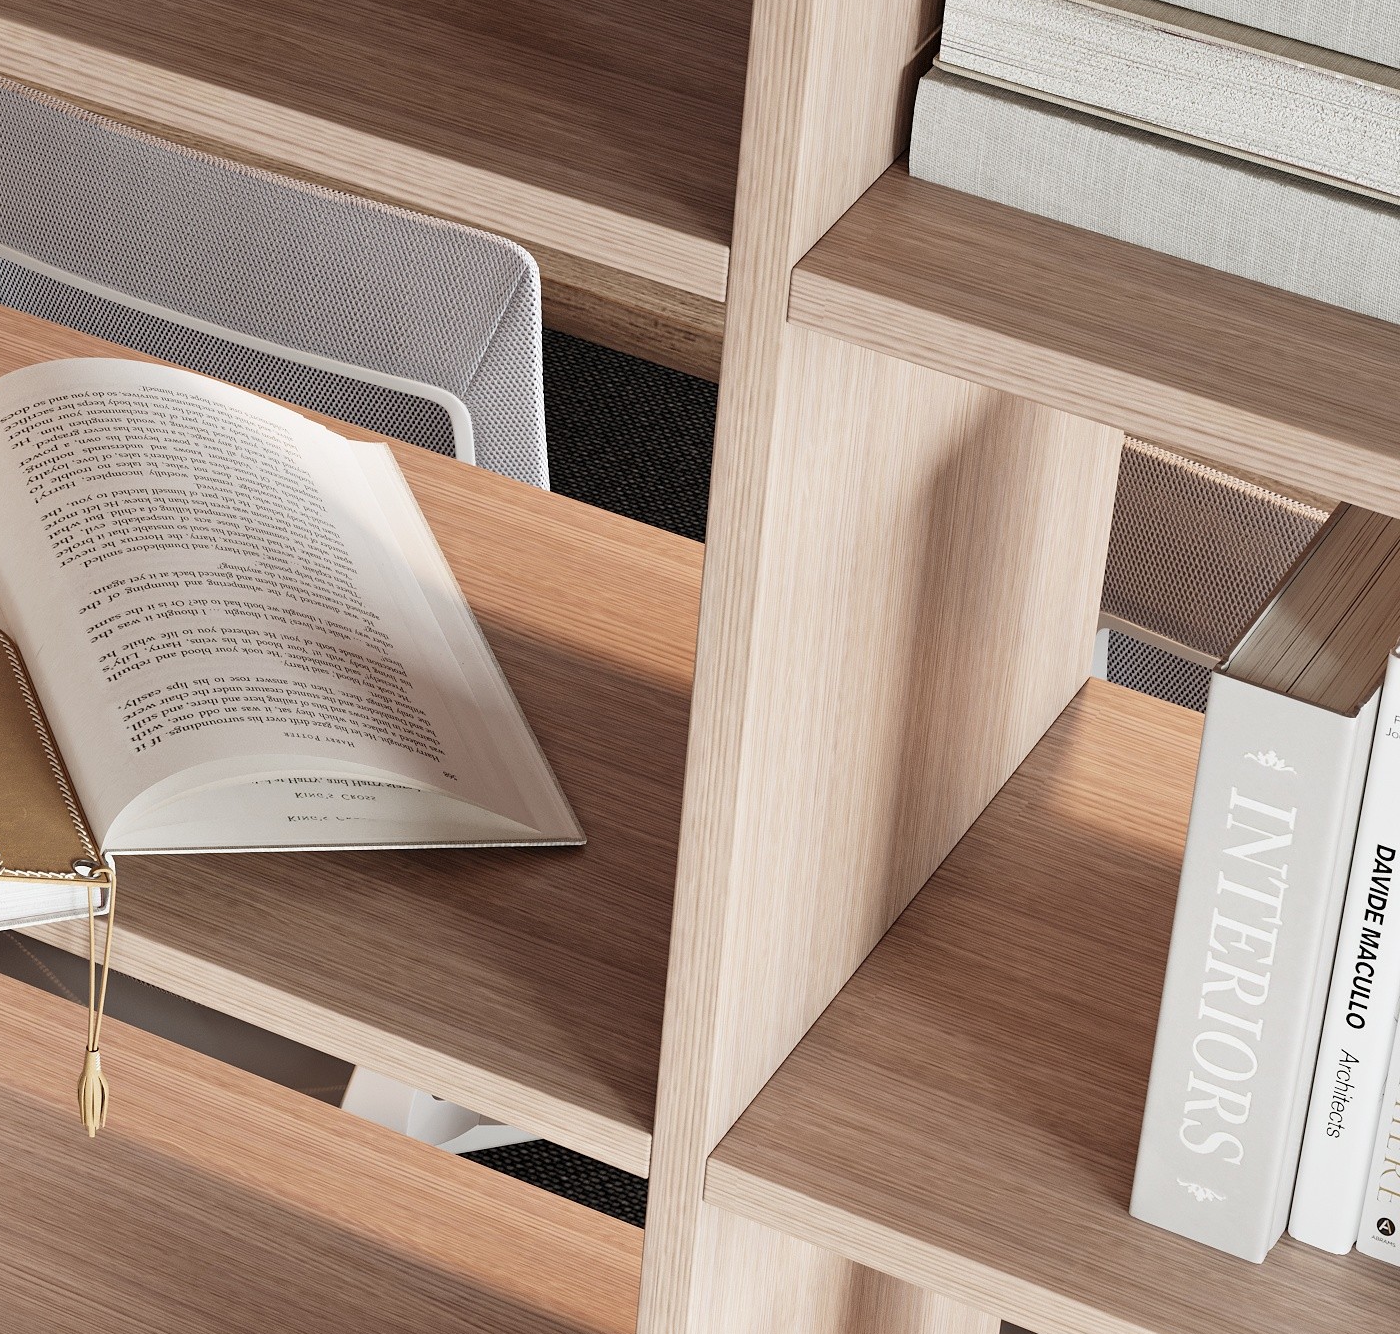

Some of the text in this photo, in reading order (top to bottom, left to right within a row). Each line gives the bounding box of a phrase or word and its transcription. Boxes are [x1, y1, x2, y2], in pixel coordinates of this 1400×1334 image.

[1179, 786, 1298, 1166] INTERIORS
[1326, 843, 1396, 1139] DAVIDE MACULLO Architects
[1371, 1234, 1396, 1248] ABRAMS
